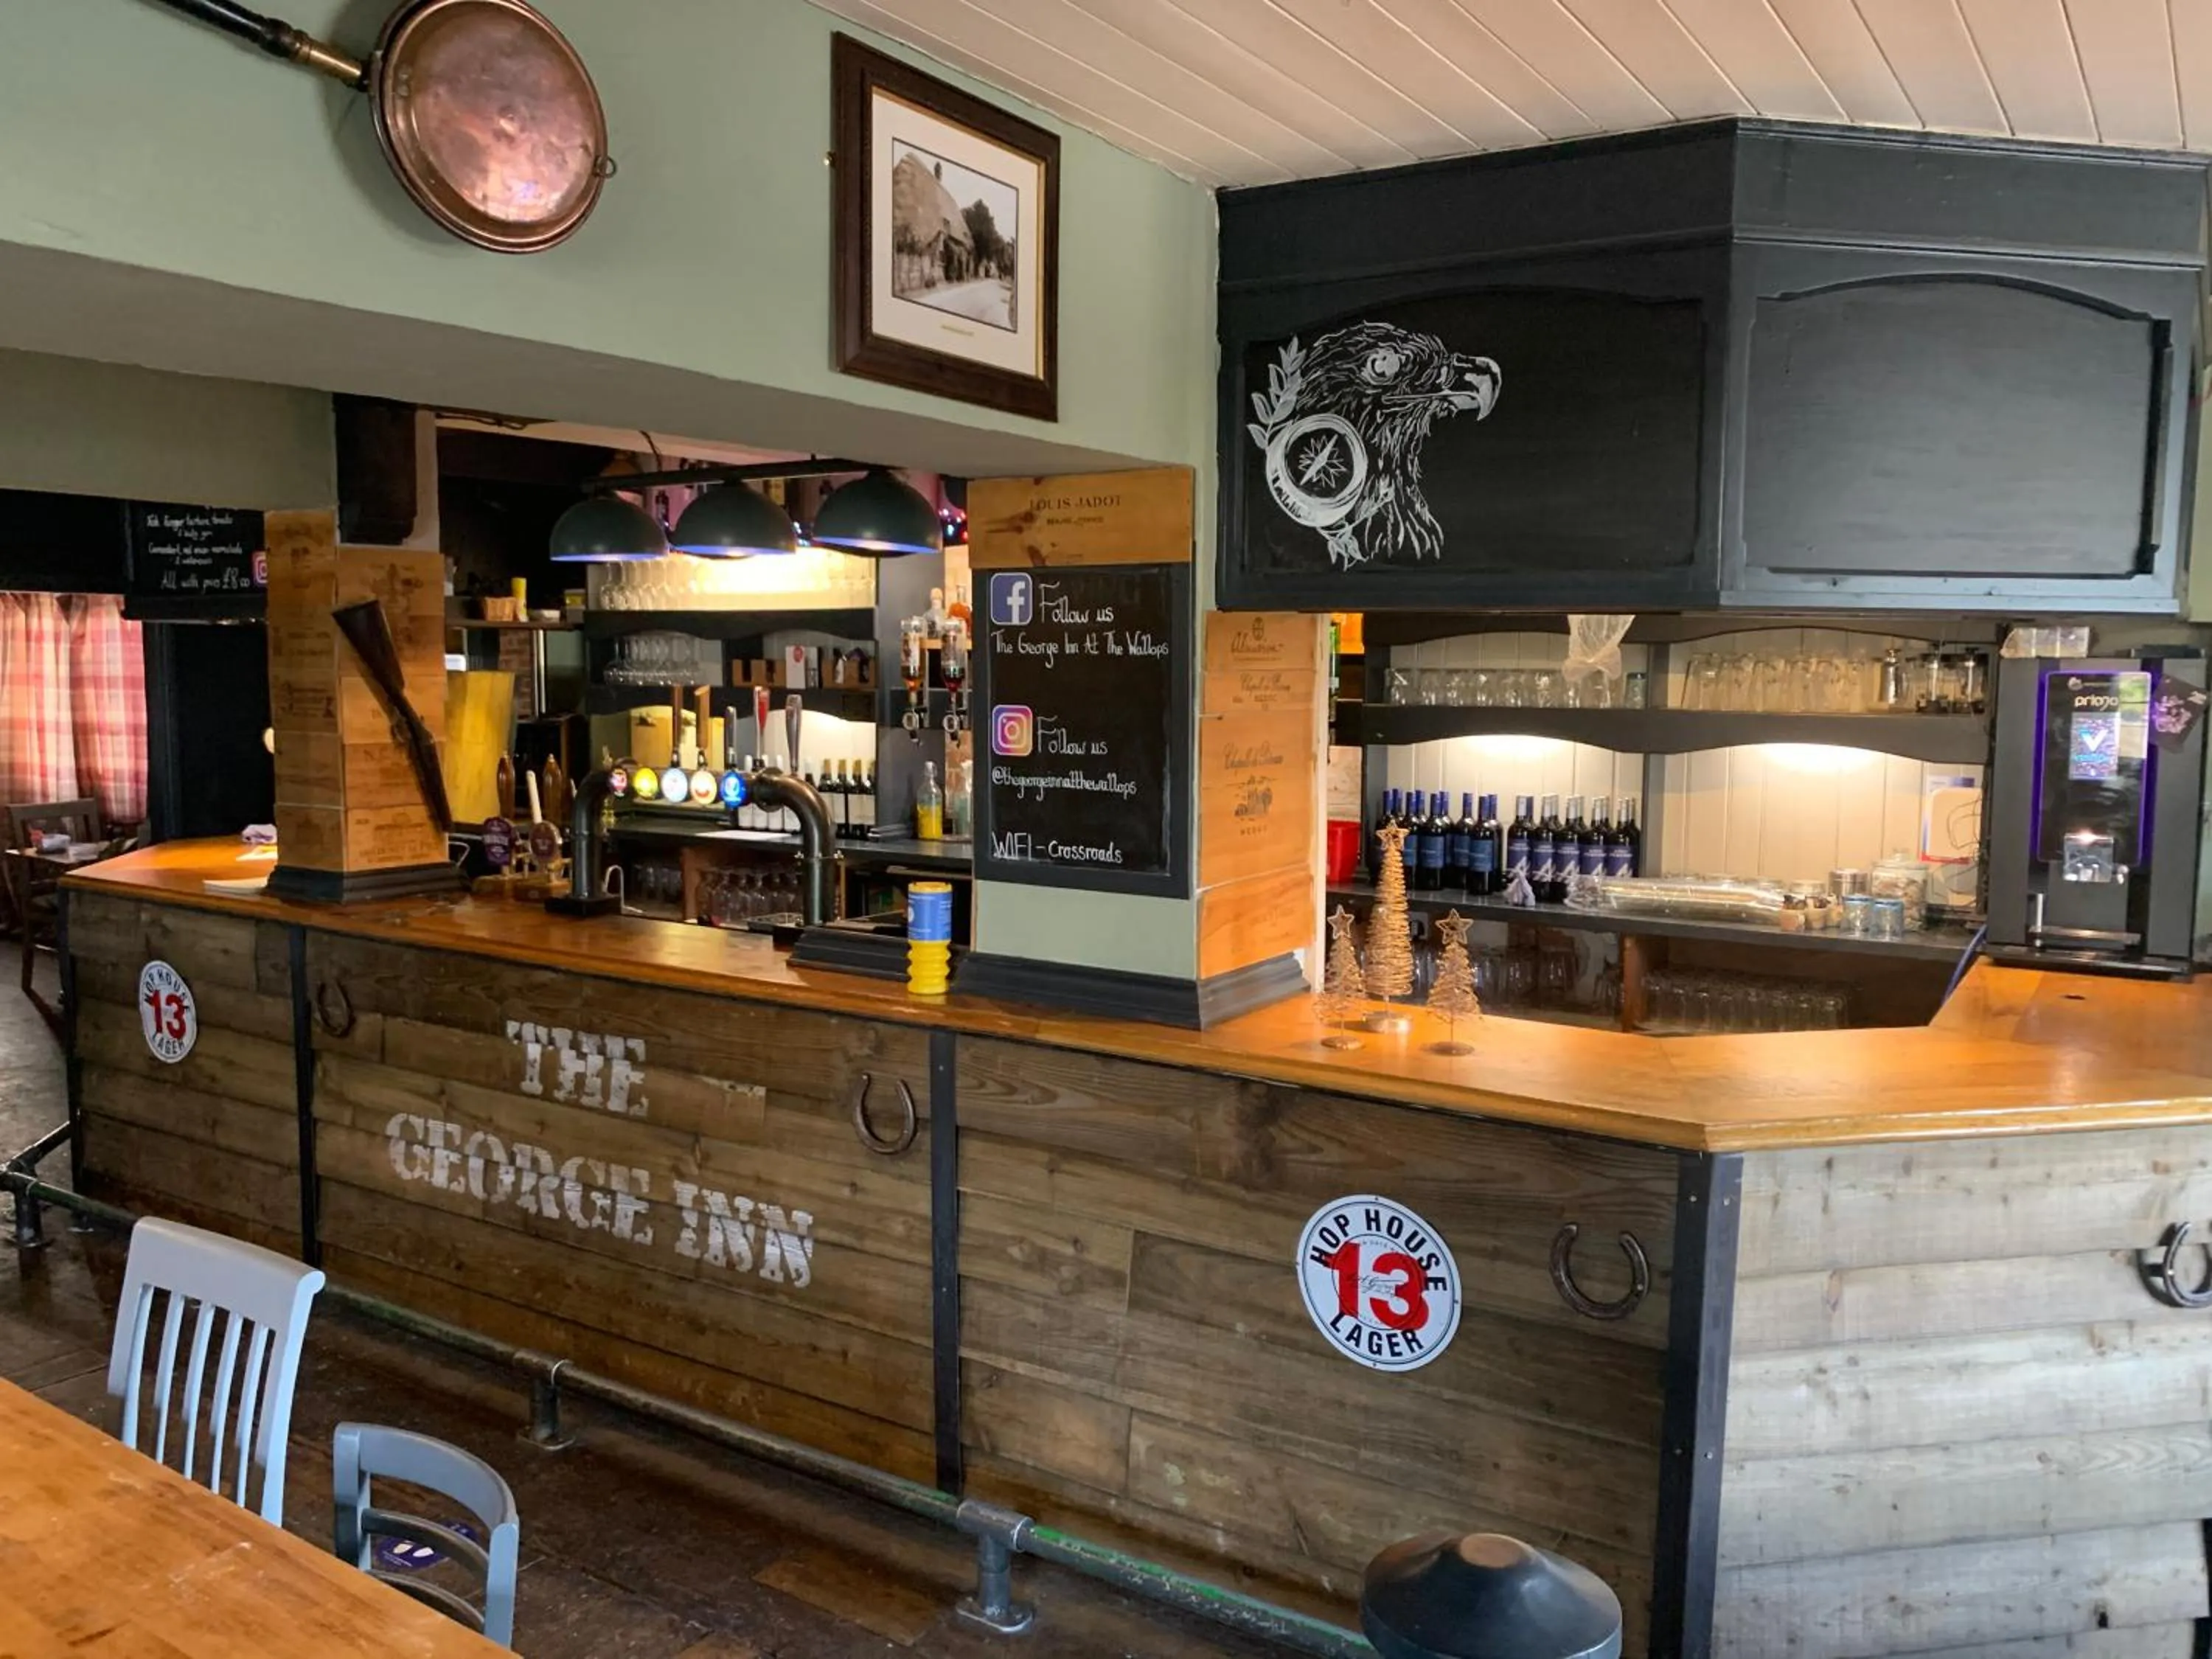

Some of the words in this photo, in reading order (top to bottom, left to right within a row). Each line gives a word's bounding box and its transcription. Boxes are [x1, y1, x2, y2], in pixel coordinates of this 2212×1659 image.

[1075, 495, 1121, 508] JADOT
[1038, 581, 1089, 624] Follow
[1095, 606, 1115, 623] us
[991, 628, 1013, 655] The
[1018, 632, 1059, 669] George
[1065, 632, 1079, 655] Inn
[1083, 632, 1099, 655] At
[1103, 629, 1124, 655] The
[1126, 630, 1169, 660] Wallops
[1037, 715, 1086, 756] Follow
[1091, 741, 1108, 756] us
[147, 989, 187, 1040] 13
[152, 1032, 184, 1054] LAGER
[506, 1020, 649, 1117] THE
[386, 1112, 653, 1246] GEORGE
[673, 1180, 813, 1288] INN
[1310, 1214, 1350, 1268] HOP
[1365, 1208, 1447, 1292] HOUSE
[1325, 1240, 1430, 1332] 13
[1329, 1312, 1424, 1357] LAGER
